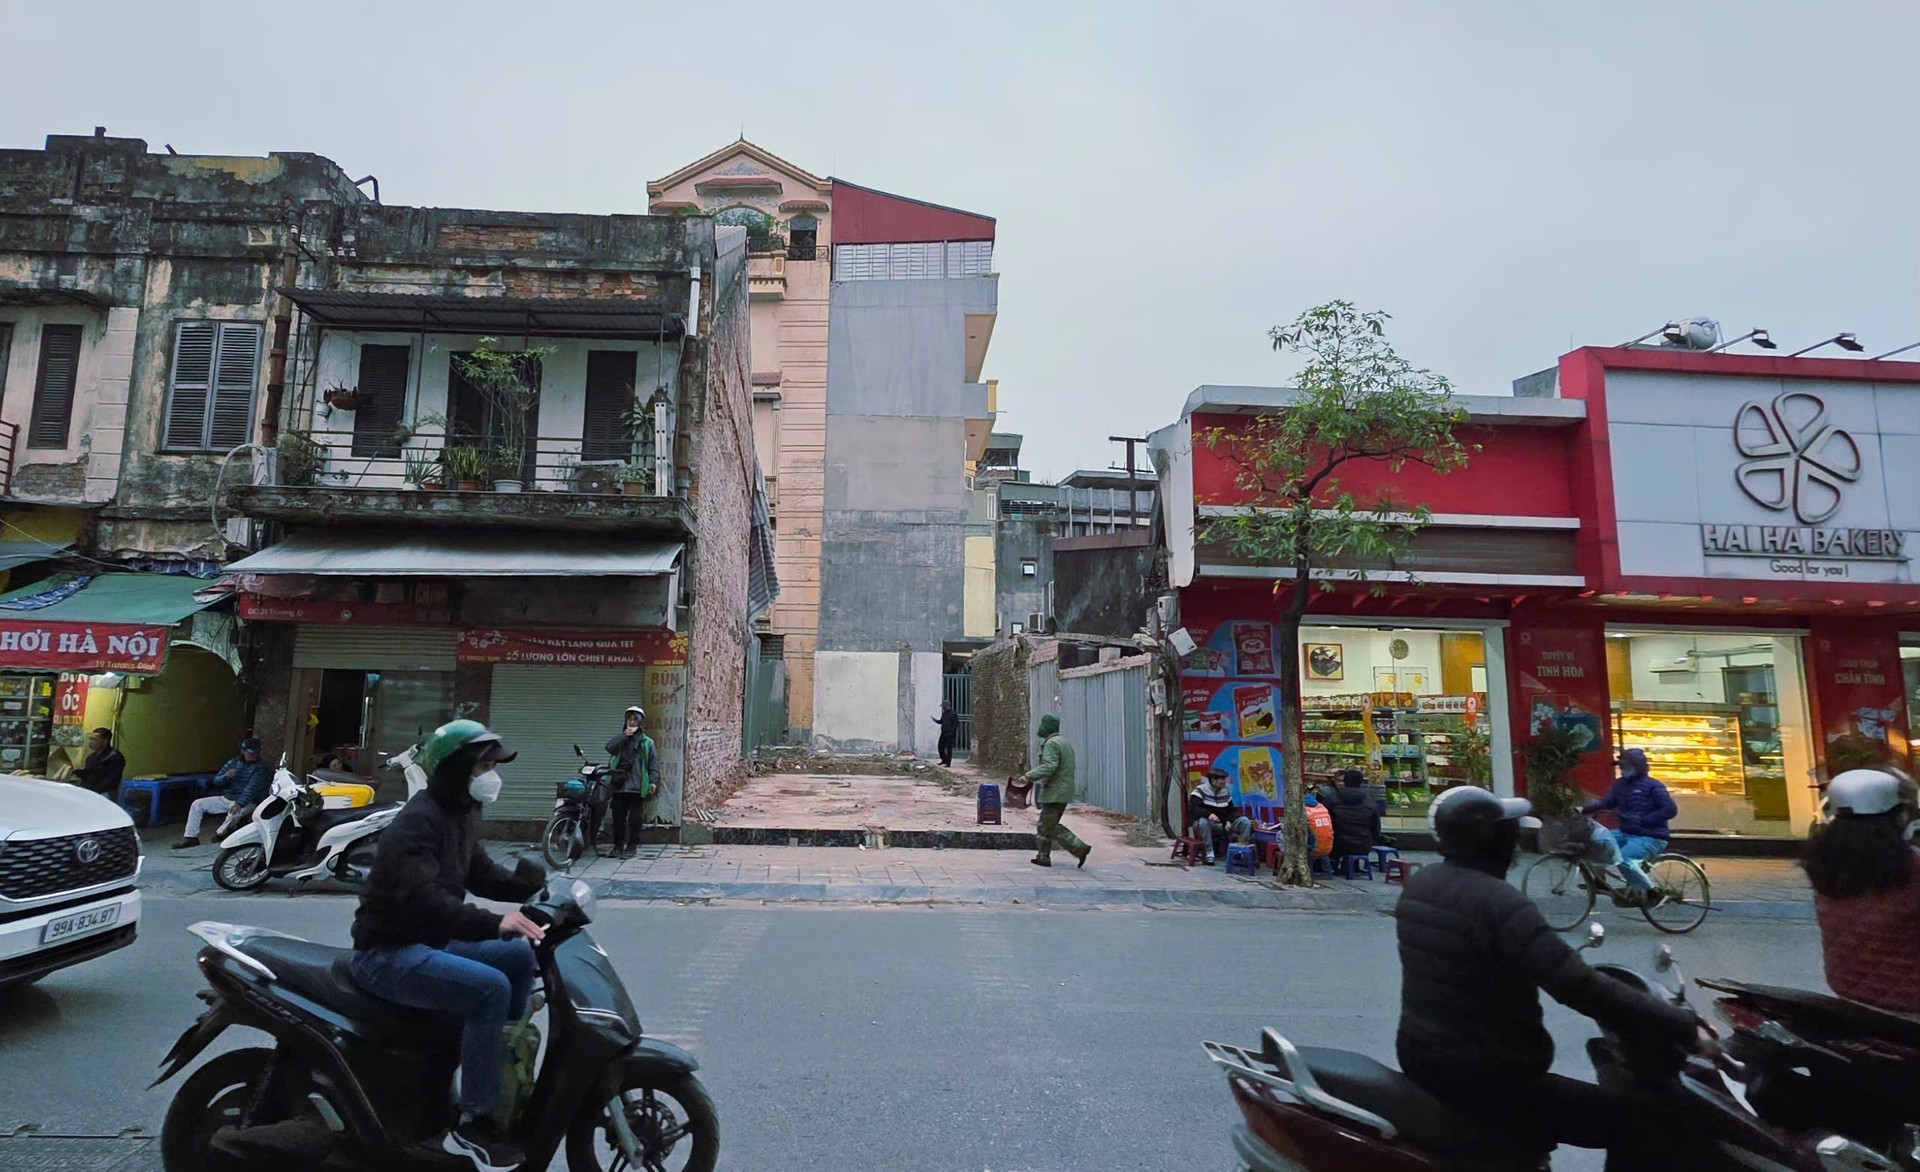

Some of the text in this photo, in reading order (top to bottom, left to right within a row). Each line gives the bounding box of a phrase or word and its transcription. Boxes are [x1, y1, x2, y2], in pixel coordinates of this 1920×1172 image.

[1701, 525, 1904, 555] HAI HA BAKERY
[1770, 560, 1802, 574] Good
[1805, 561, 1819, 574] for
[1, 628, 159, 661] HƠI HÀ NỘI
[651, 669, 680, 686] BÚN
